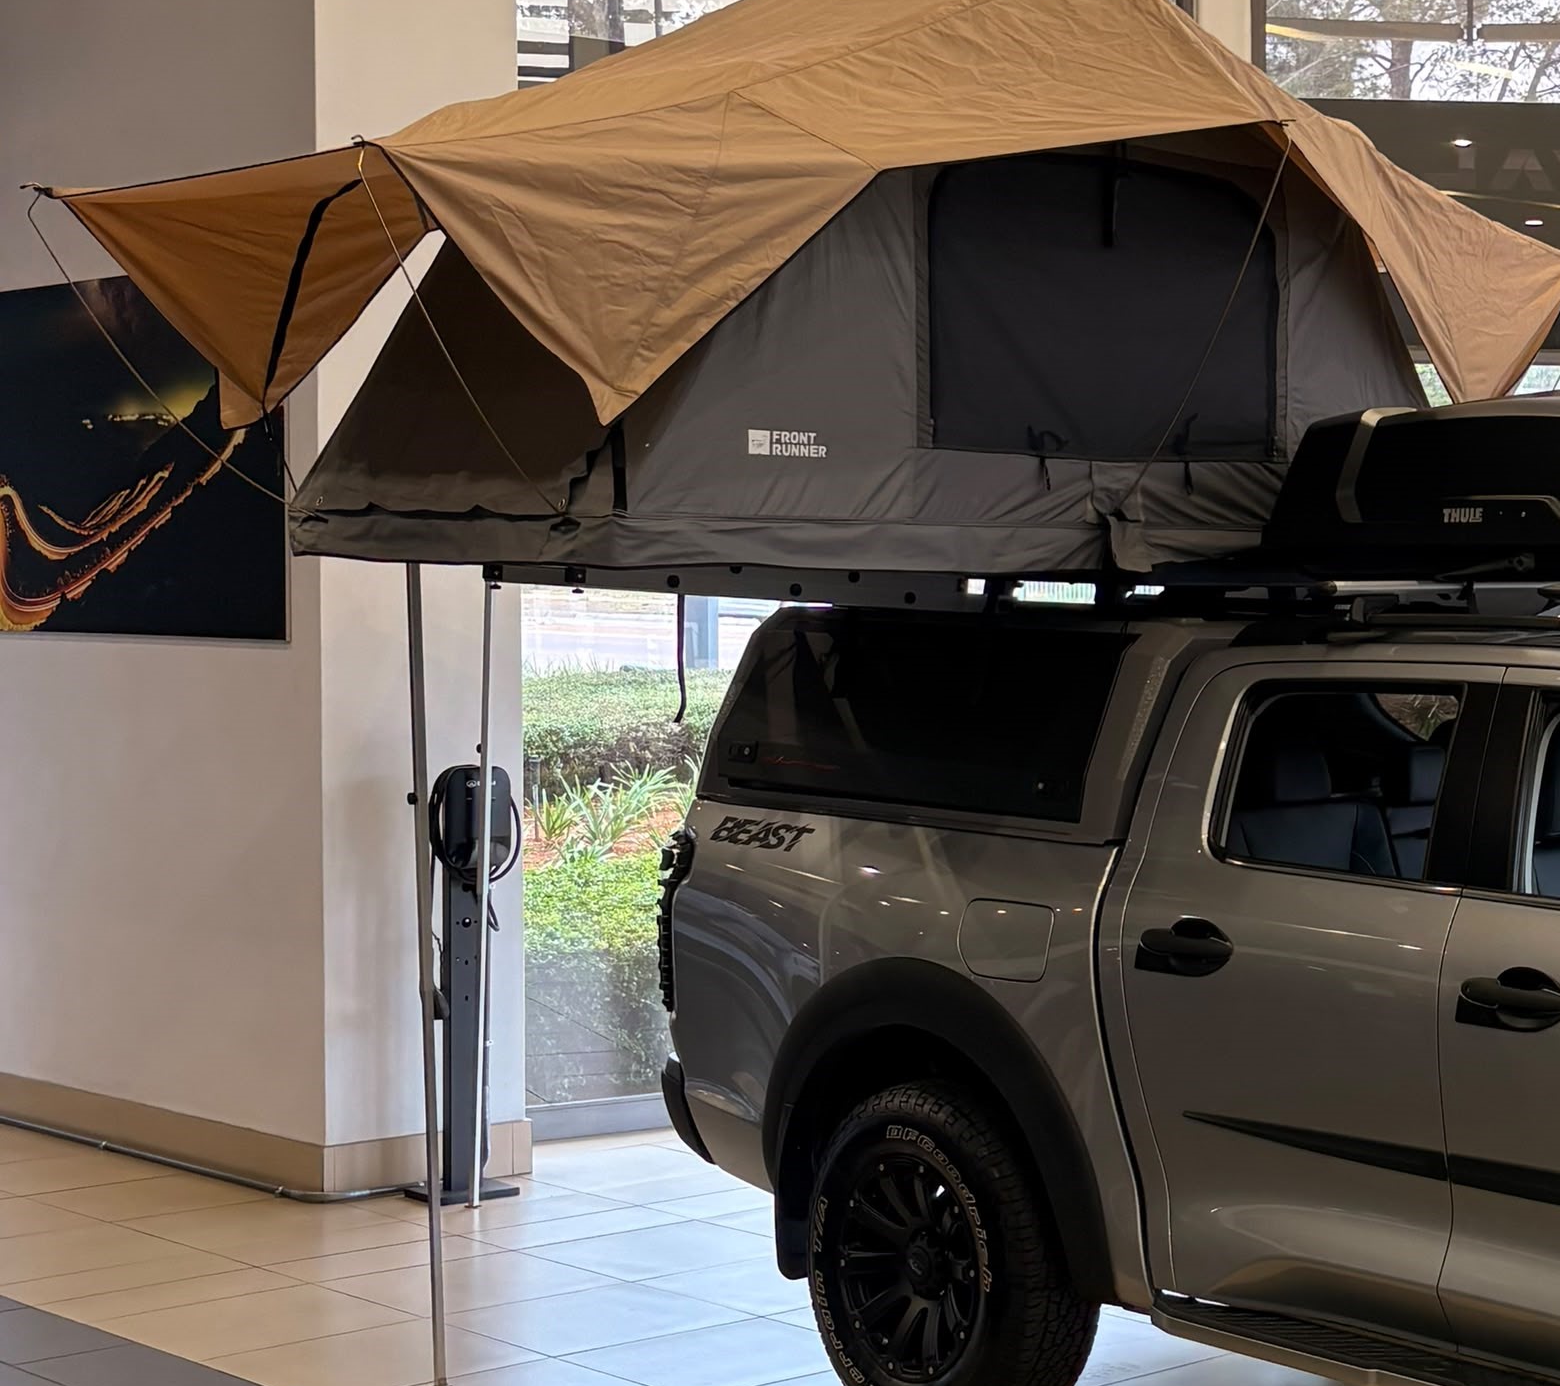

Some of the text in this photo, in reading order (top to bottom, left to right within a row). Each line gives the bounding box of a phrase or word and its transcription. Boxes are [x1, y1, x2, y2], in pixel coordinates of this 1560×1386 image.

[772, 431, 817, 445] FRONT
[772, 444, 828, 458] RUNNER
[1442, 507, 1484, 524] THULE
[710, 816, 815, 853] BEAST
[886, 1124, 994, 1293] BFGoodrich
